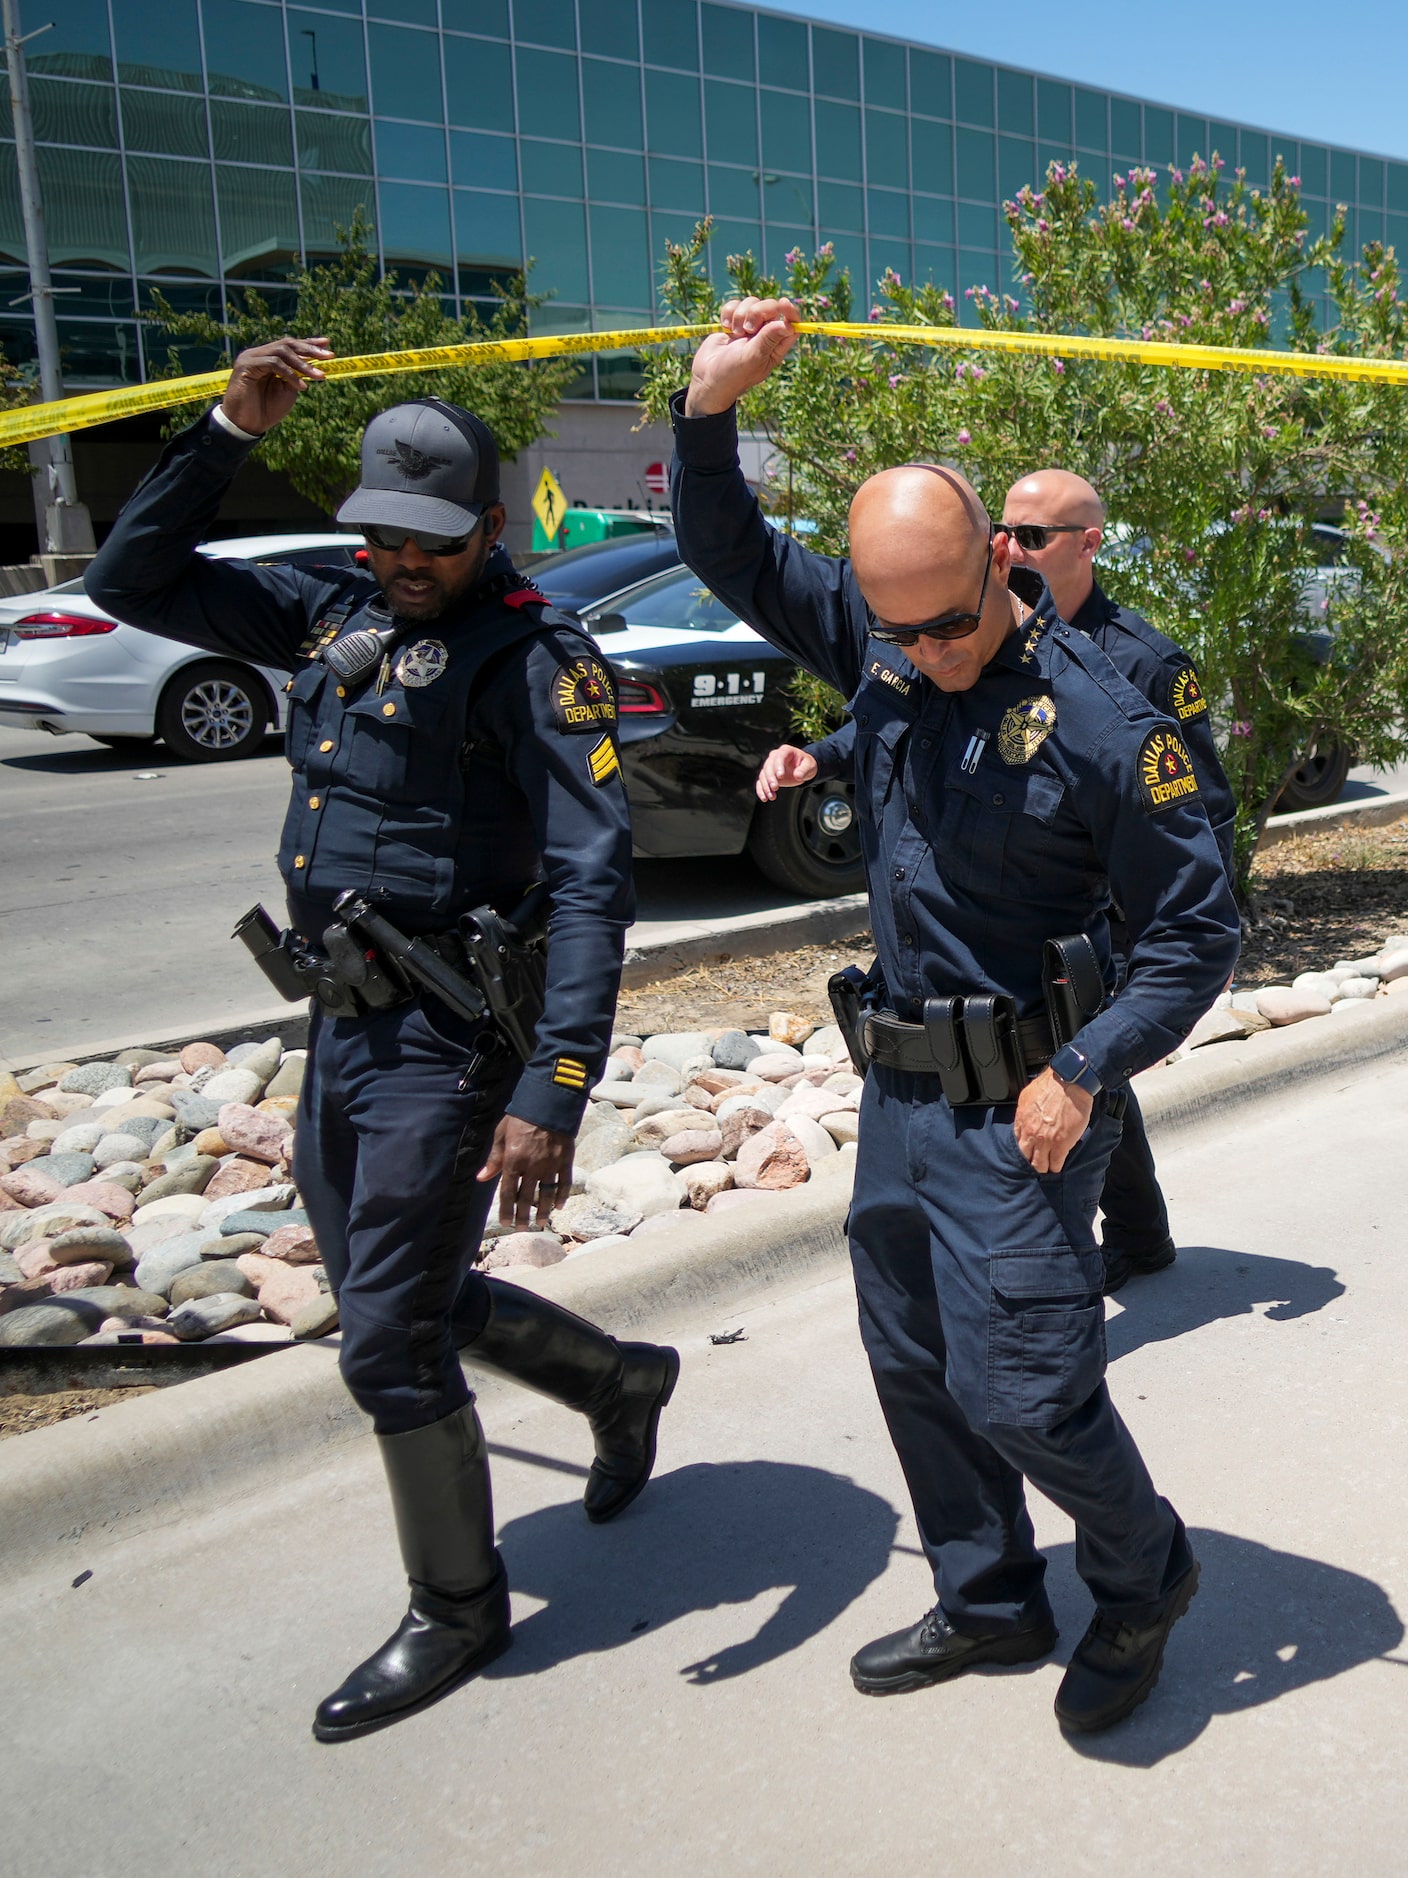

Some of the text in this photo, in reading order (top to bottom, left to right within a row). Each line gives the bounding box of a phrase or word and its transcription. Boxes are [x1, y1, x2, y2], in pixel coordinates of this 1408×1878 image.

[558, 662, 616, 706] DALLAS POLICE
[880, 669, 911, 696] GARCIA
[1173, 670, 1190, 707] DALLAS
[564, 703, 617, 724] DEPARTMEN
[690, 694, 764, 708] EMERGENCY
[1142, 733, 1194, 785] DALLAS POLICE
